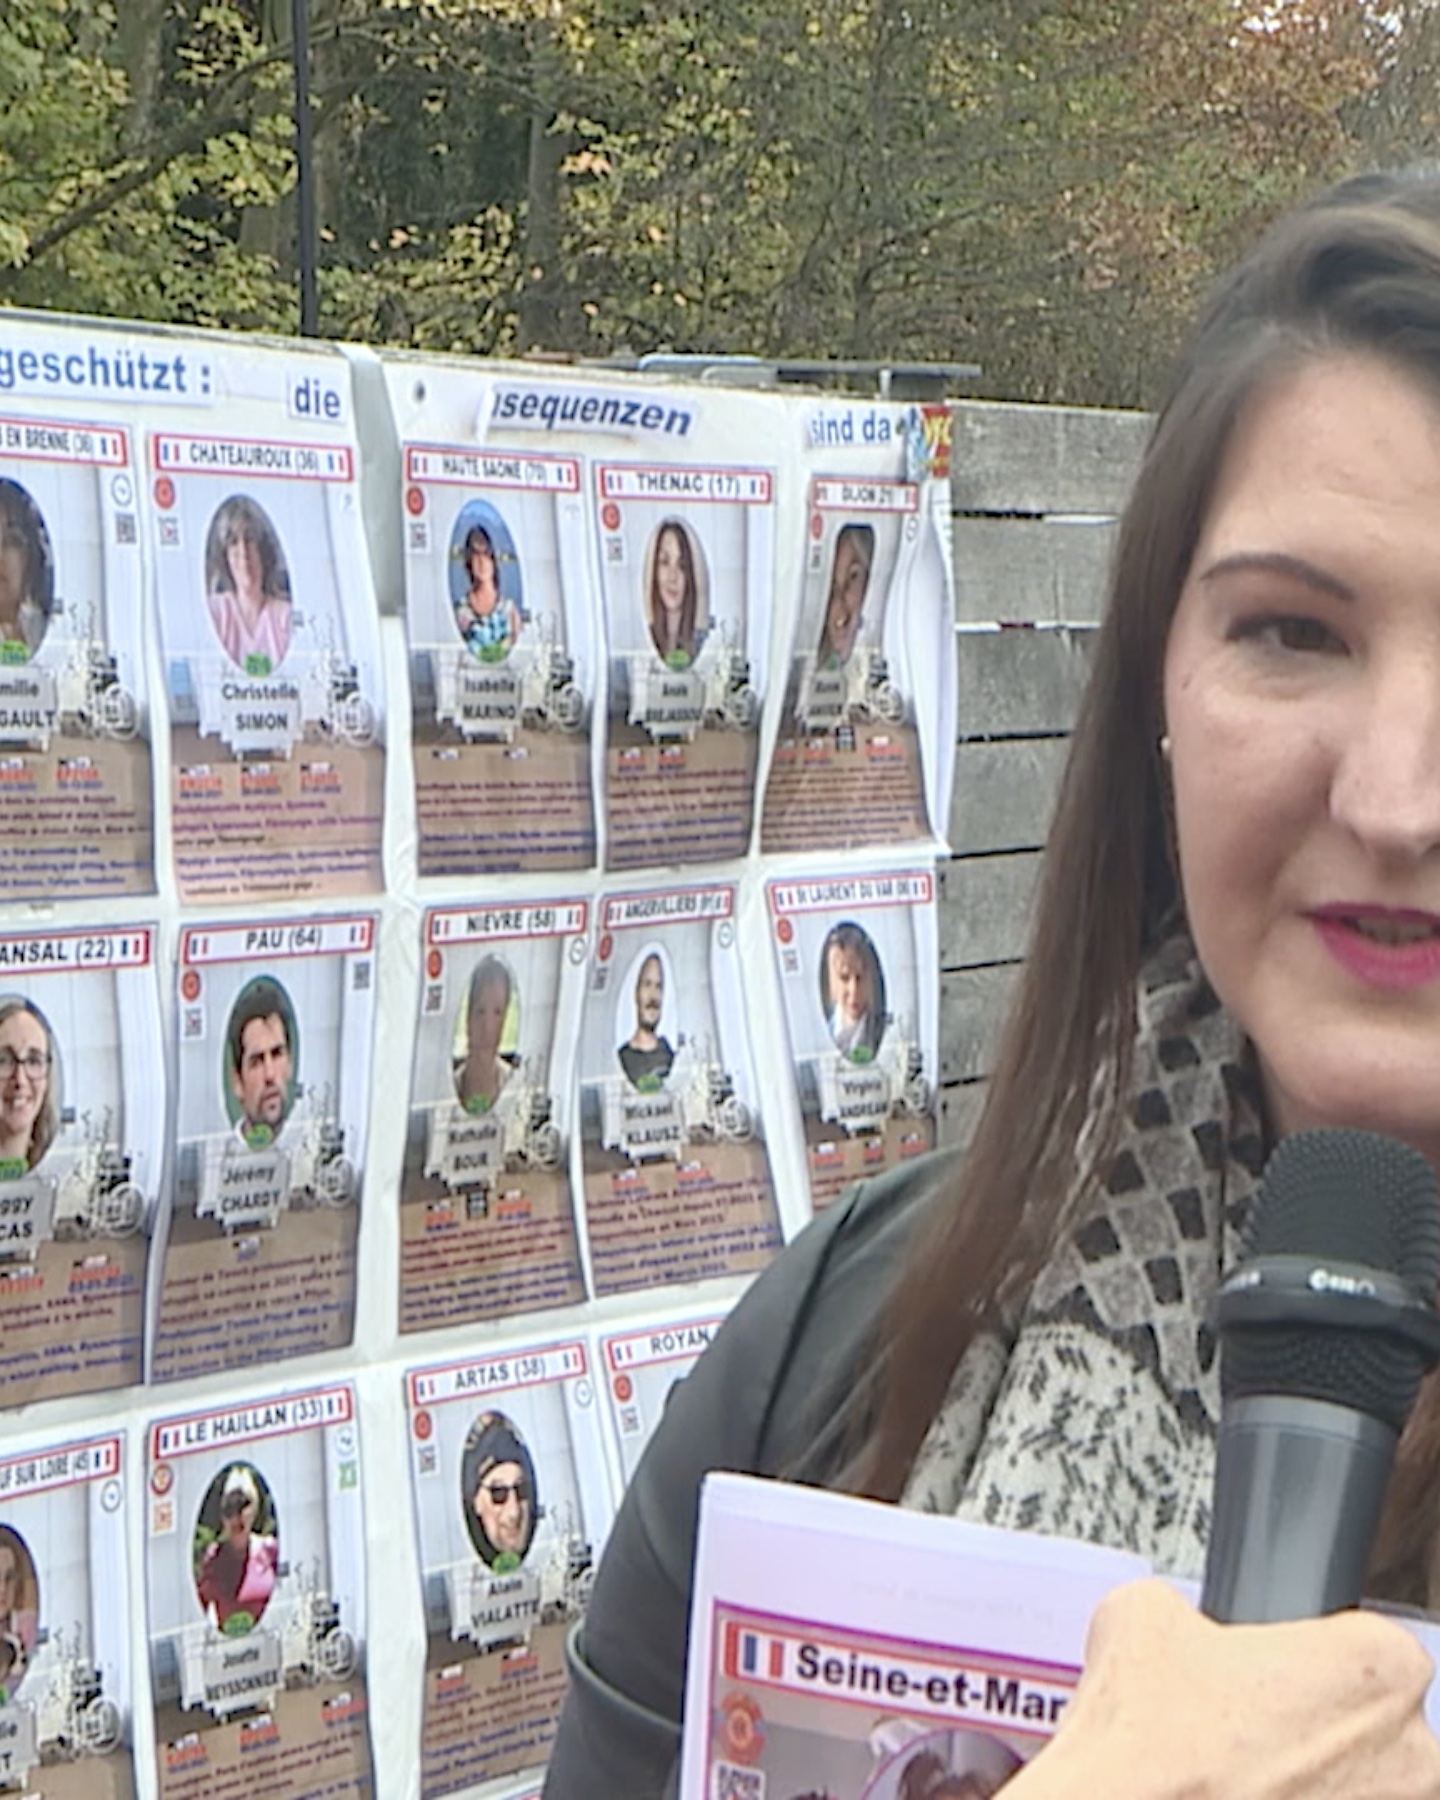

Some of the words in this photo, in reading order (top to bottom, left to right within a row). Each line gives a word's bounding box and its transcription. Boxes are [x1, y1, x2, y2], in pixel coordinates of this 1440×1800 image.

[0, 346, 187, 393] geschützt
[294, 377, 341, 418] die
[811, 408, 854, 443] sind
[862, 409, 891, 441] da
[26, 429, 70, 451] BRENNE
[189, 442, 292, 469] CHATEAUROUX
[443, 457, 479, 478] HAUTE
[637, 473, 703, 493] THENAC
[709, 476, 741, 498] (17)
[222, 682, 299, 701] Christelle
[236, 712, 288, 731] SIMON
[809, 883, 856, 902] LAURENT
[76, 938, 114, 966] (22)
[246, 930, 285, 951] PAU
[289, 926, 322, 953] (64)
[454, 1364, 509, 1390] ARTAS
[514, 1356, 546, 1383] (38)
[185, 1421, 207, 1443] LE
[212, 1404, 287, 1438] HAILLAN
[293, 1398, 323, 1427] (33)
